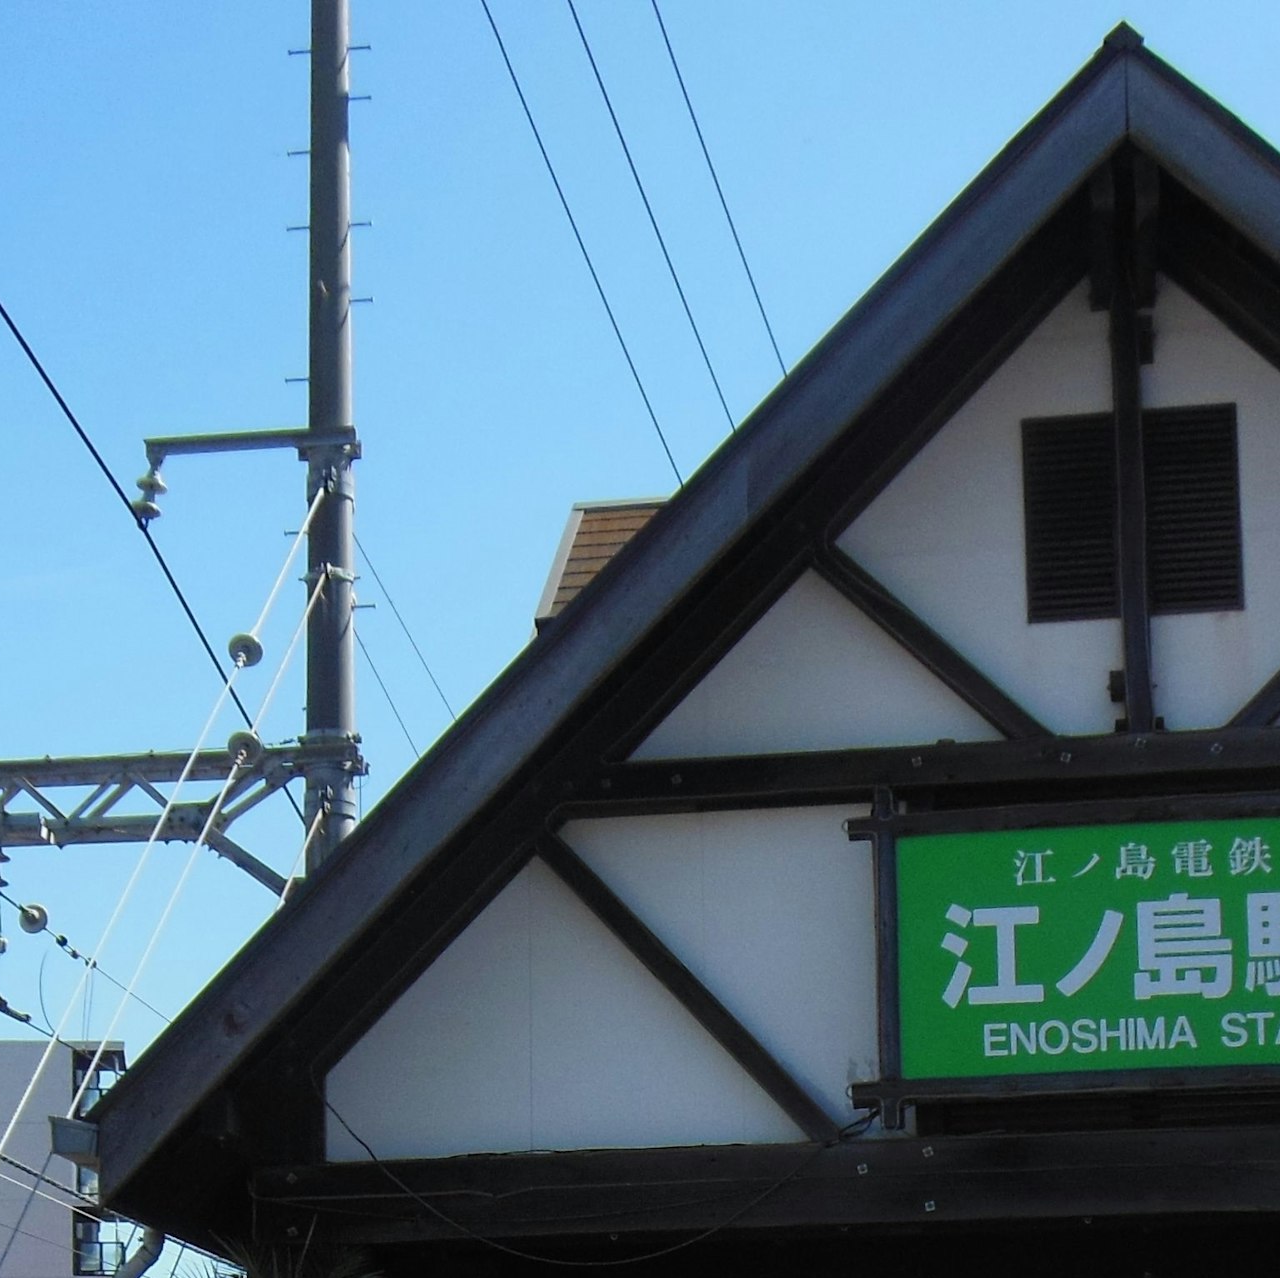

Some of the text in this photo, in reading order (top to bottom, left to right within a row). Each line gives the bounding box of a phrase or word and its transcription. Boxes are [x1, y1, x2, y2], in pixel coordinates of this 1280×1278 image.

[1013, 836, 1273, 886] 江ノ島電鉄
[983, 1015, 1198, 1057] ENOSHIMA
